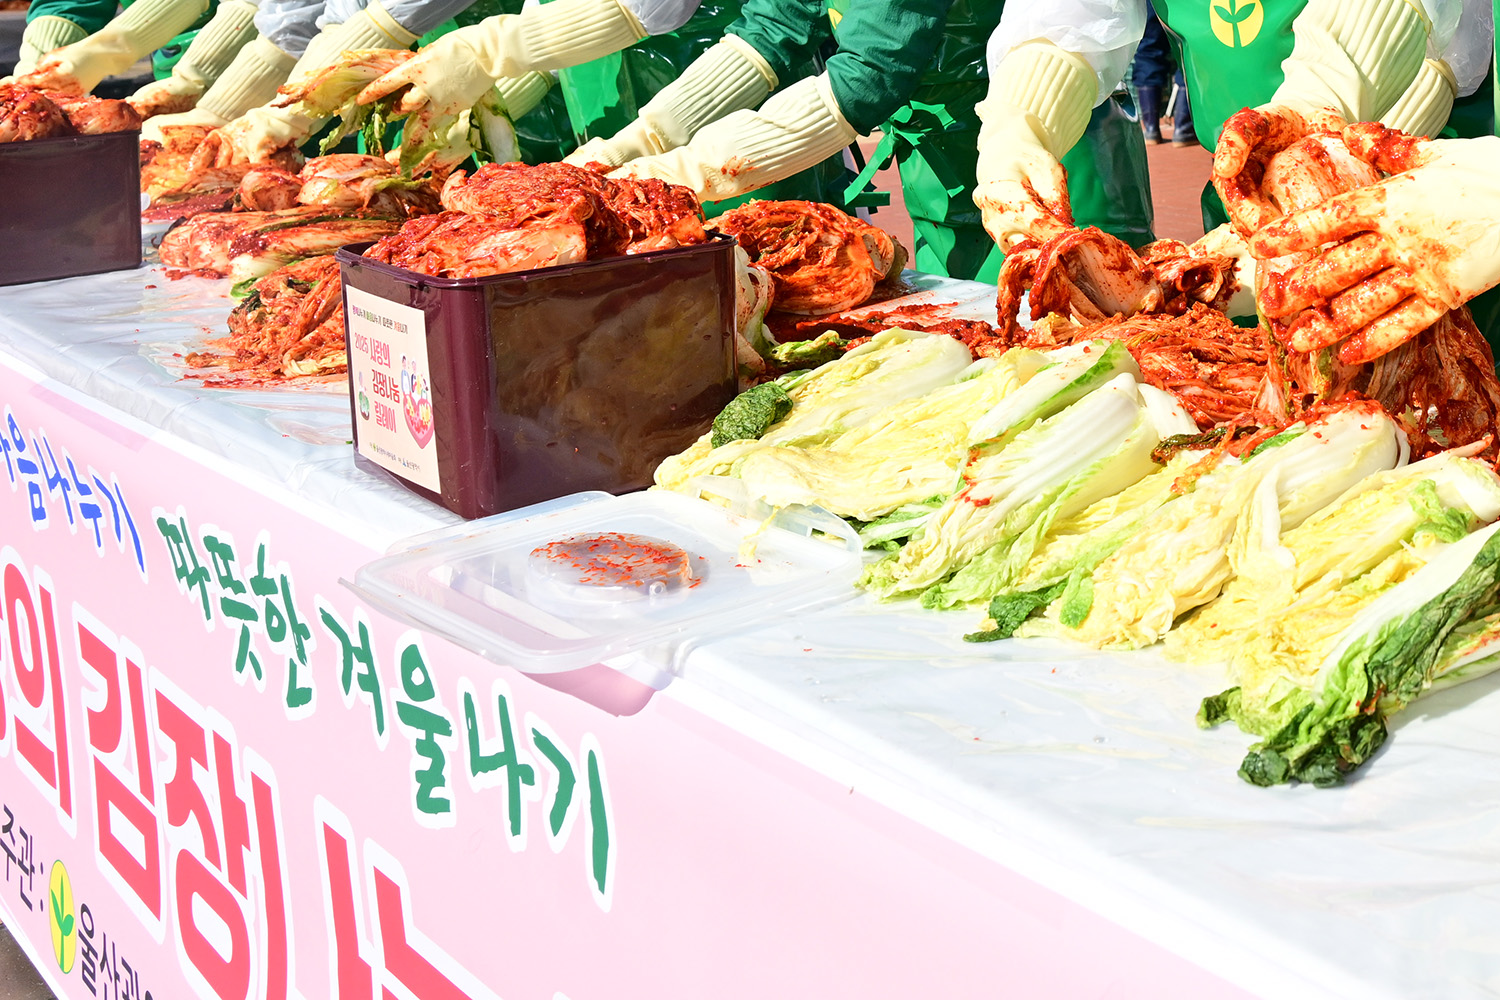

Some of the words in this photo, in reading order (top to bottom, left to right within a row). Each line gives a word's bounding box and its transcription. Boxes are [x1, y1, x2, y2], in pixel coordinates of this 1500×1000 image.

[354, 331, 369, 354] 2025
[369, 337, 391, 368] 사랑의
[371, 368, 400, 404] 김장나눔
[374, 400, 397, 434] 릴레이
[156, 516, 313, 708] 따뜻한
[319, 606, 609, 895] 겨울나기
[0, 562, 73, 820] 의
[77, 620, 474, 1000] 김장나
[78, 902, 154, 1000] 울산
